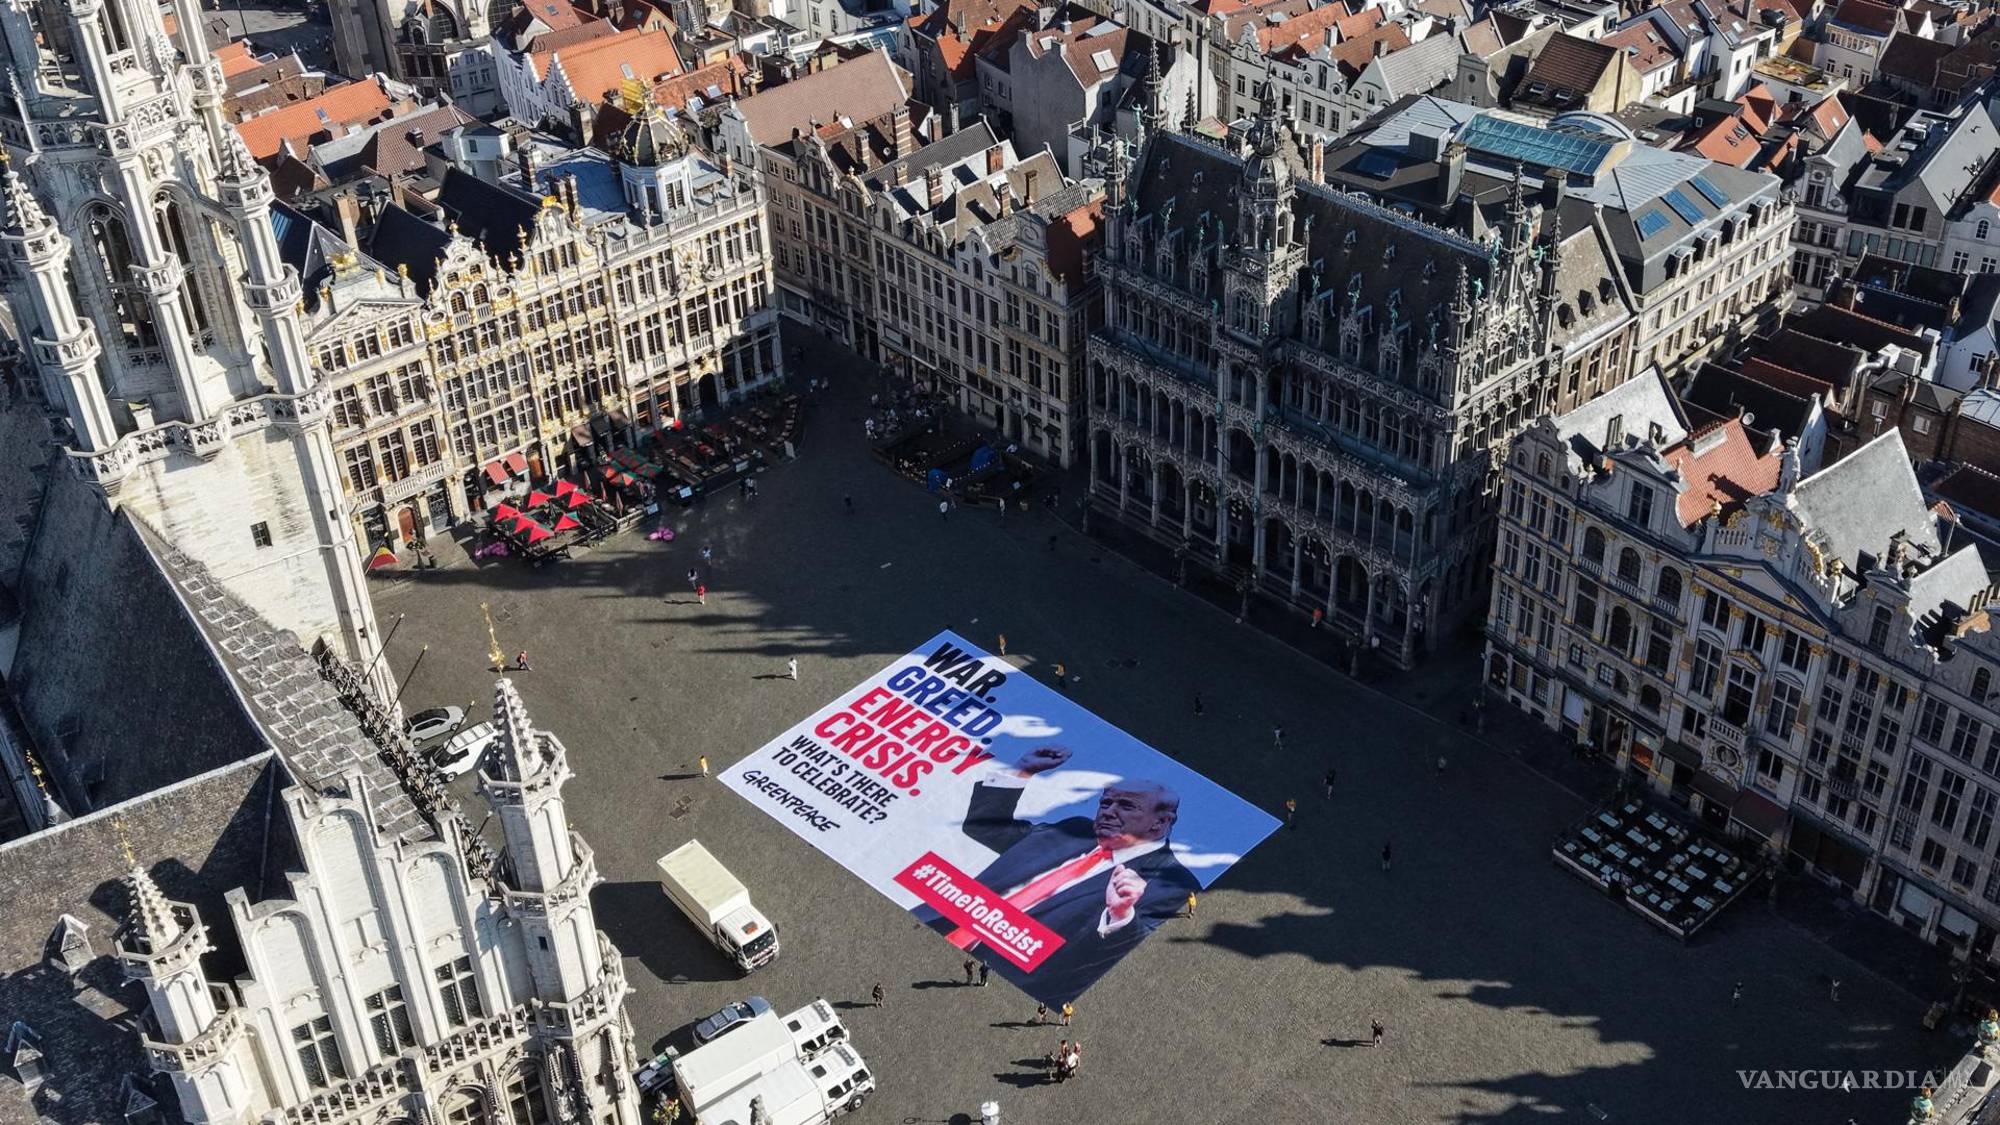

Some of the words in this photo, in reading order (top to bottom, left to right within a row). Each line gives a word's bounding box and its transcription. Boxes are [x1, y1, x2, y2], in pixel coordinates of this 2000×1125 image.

[888, 665, 1003, 745] GREED.
[923, 641, 1007, 704] WAR.
[815, 711, 934, 797] CRISIS.
[849, 686, 995, 775] ENERGY
[742, 770, 841, 832] GREENPEACE
[771, 746, 798, 767] TO
[791, 761, 888, 825] CELEBRATE?
[790, 734, 850, 776] WHAT'S
[845, 770, 899, 808] THERE
[912, 863, 1044, 957] #TimeToResist
